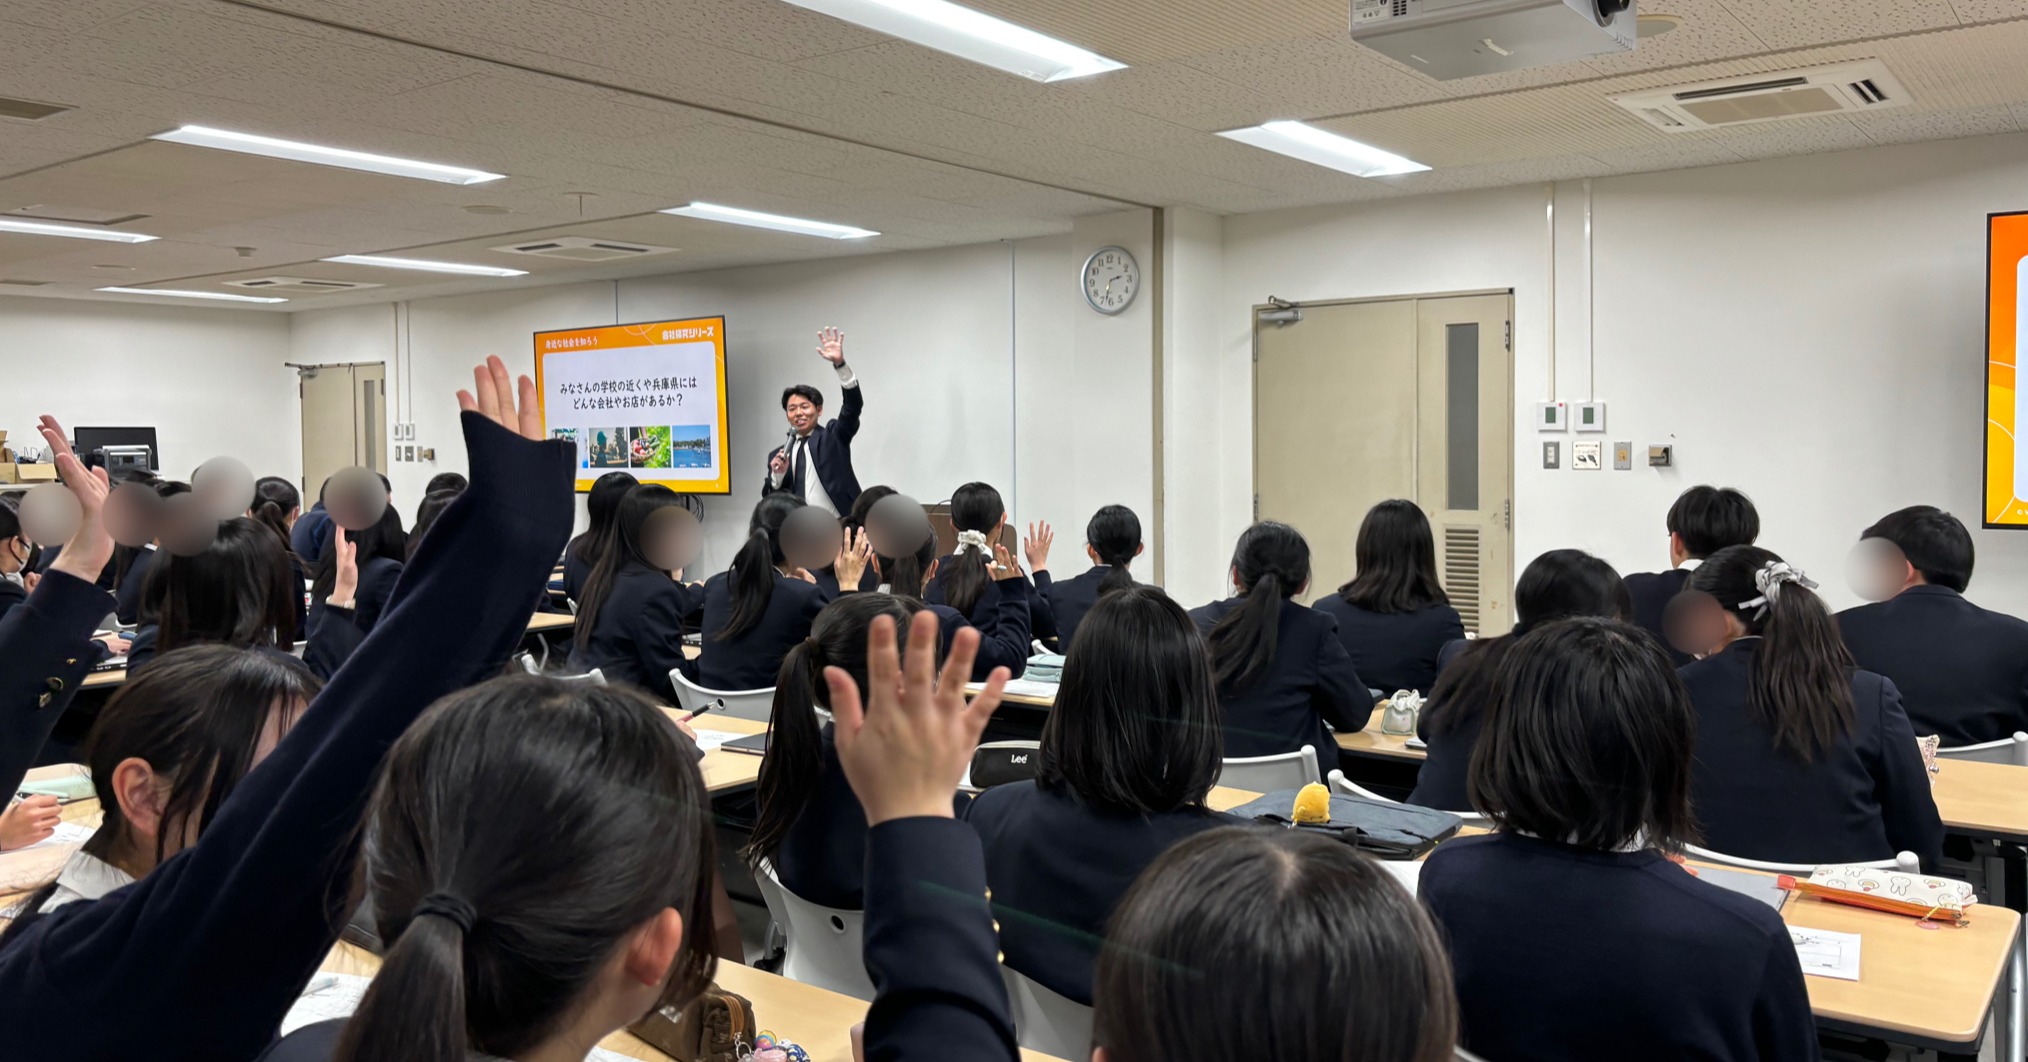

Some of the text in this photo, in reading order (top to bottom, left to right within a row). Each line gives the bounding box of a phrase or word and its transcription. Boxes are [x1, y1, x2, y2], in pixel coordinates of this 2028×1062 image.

[1098, 258, 1104, 267] 11
[1106, 254, 1113, 264] 12
[1117, 256, 1121, 265] 1
[1092, 267, 1099, 276] 10
[1123, 264, 1128, 273] 2
[1089, 279, 1095, 287] 9
[1127, 274, 1132, 283] 3
[1093, 289, 1098, 297] 8
[1124, 286, 1128, 294] 4
[1099, 296, 1105, 305] 7
[1108, 297, 1114, 306] 6
[1117, 295, 1122, 303] 5
[545, 335, 598, 350] 身近な社会を知ろう
[560, 376, 697, 395] みなさんの学校の近くや兵庫県には
[1011, 754, 1028, 764] Lee
